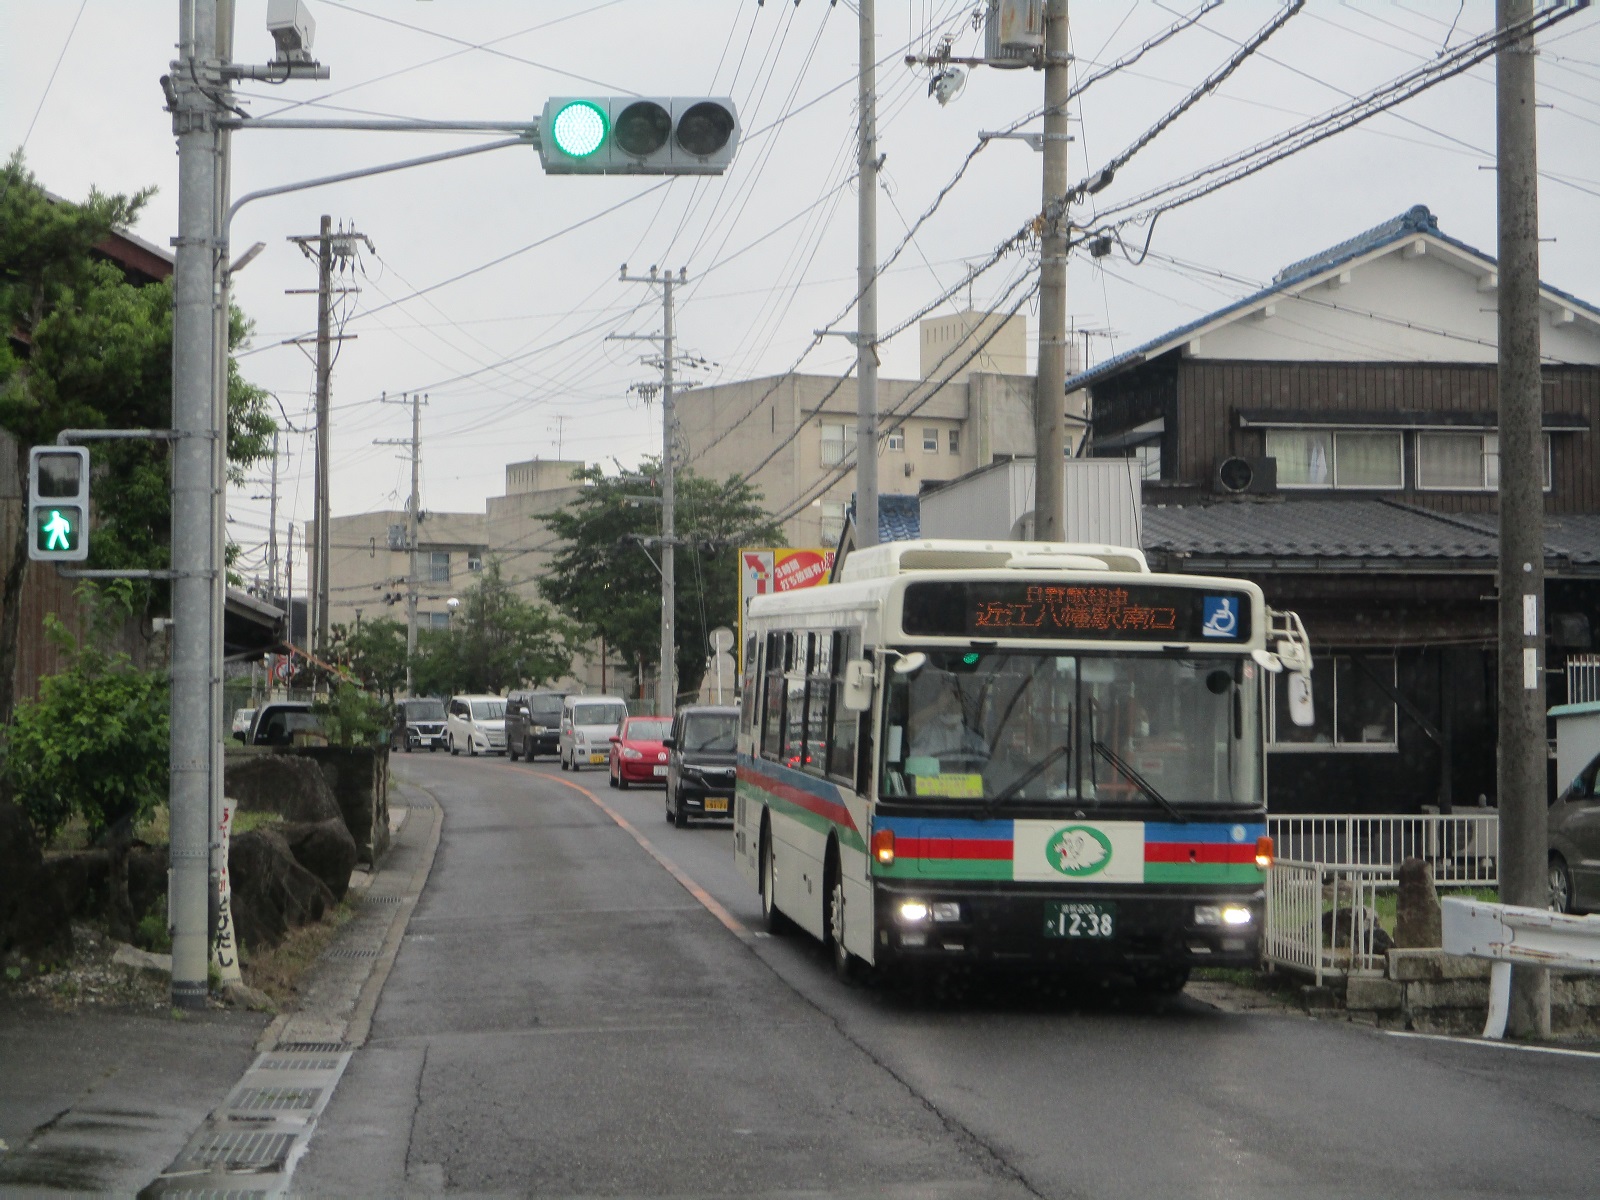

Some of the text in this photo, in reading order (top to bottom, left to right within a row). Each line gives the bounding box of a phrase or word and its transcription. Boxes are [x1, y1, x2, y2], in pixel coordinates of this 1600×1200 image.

[975, 602, 1177, 630] 近江八幡駅南口
